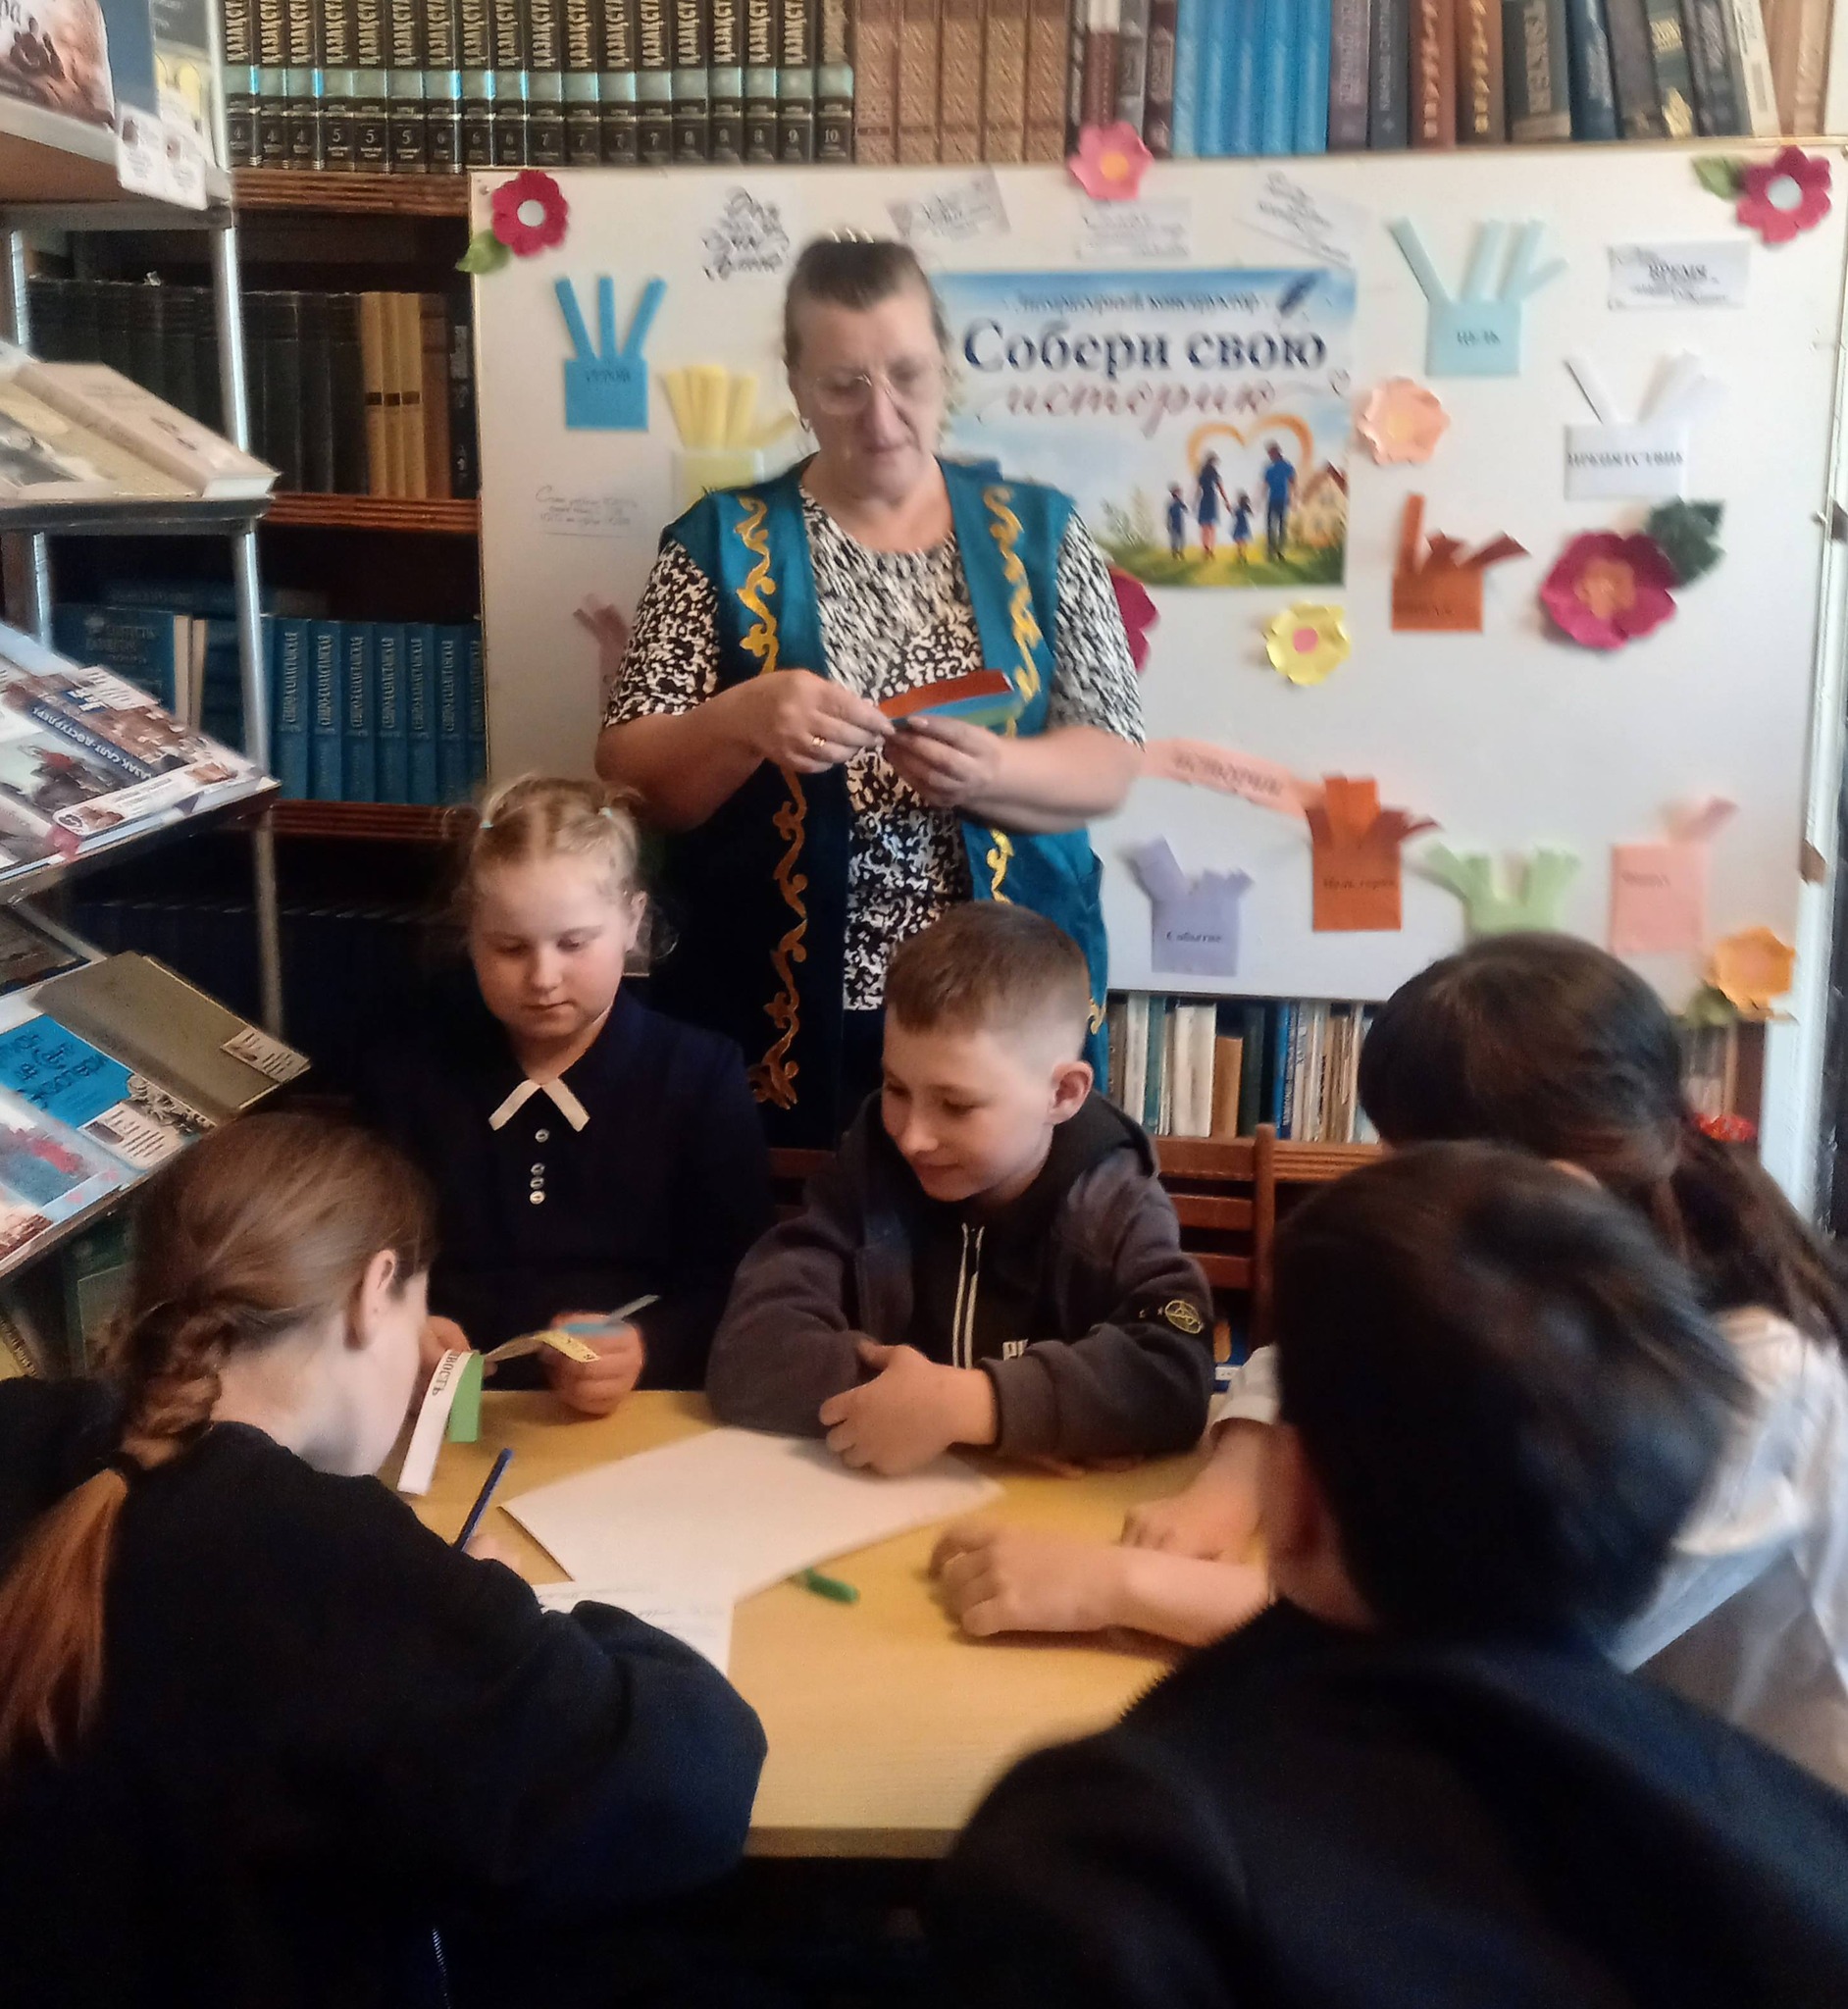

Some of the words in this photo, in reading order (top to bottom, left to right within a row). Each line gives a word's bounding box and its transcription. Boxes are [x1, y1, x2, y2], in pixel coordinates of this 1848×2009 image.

[333, 129, 341, 142] 5
[366, 129, 376, 143] 5
[402, 129, 412, 145] 5
[789, 129, 798, 143] 9
[824, 129, 840, 143] 10
[964, 317, 1173, 384] Собери
[1186, 329, 1328, 372] свою
[1005, 379, 1276, 440] историю
[120, 759, 154, 781] АЗАҚ
